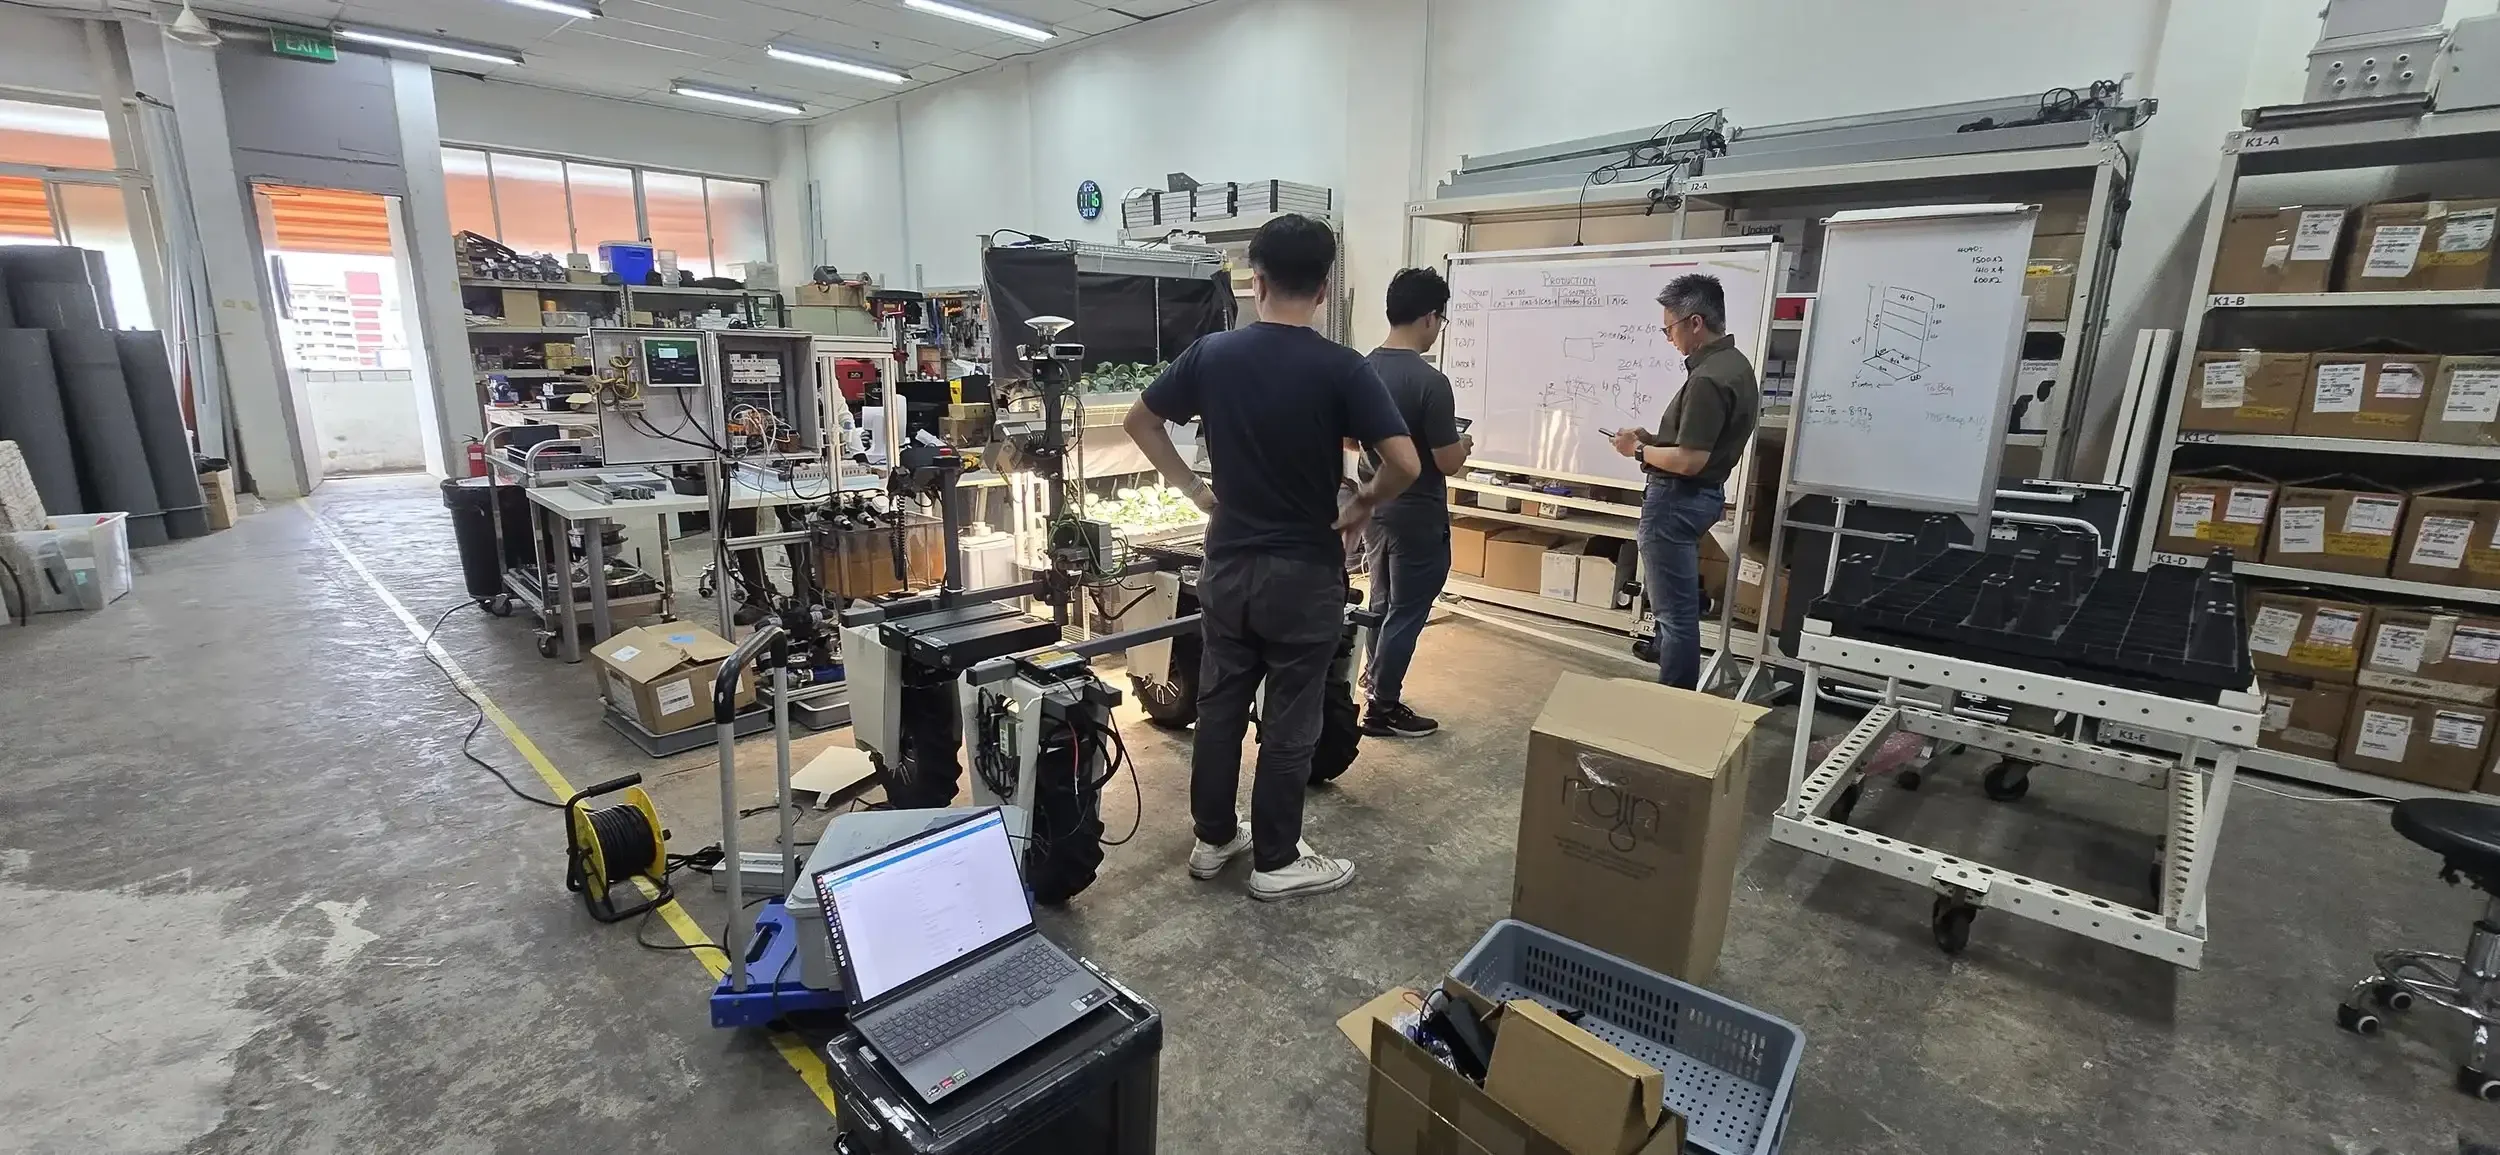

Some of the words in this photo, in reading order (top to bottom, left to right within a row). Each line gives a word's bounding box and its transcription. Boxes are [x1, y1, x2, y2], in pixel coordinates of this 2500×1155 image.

[285, 33, 320, 54] EXIT
[2245, 136, 2279, 147] K1-A
[1691, 182, 1708, 191] J2-A
[2213, 296, 2246, 306] K1-B
[2184, 432, 2216, 443] K1-C
[2157, 554, 2188, 566] K1-D
[2119, 730, 2147, 743] K1-E
